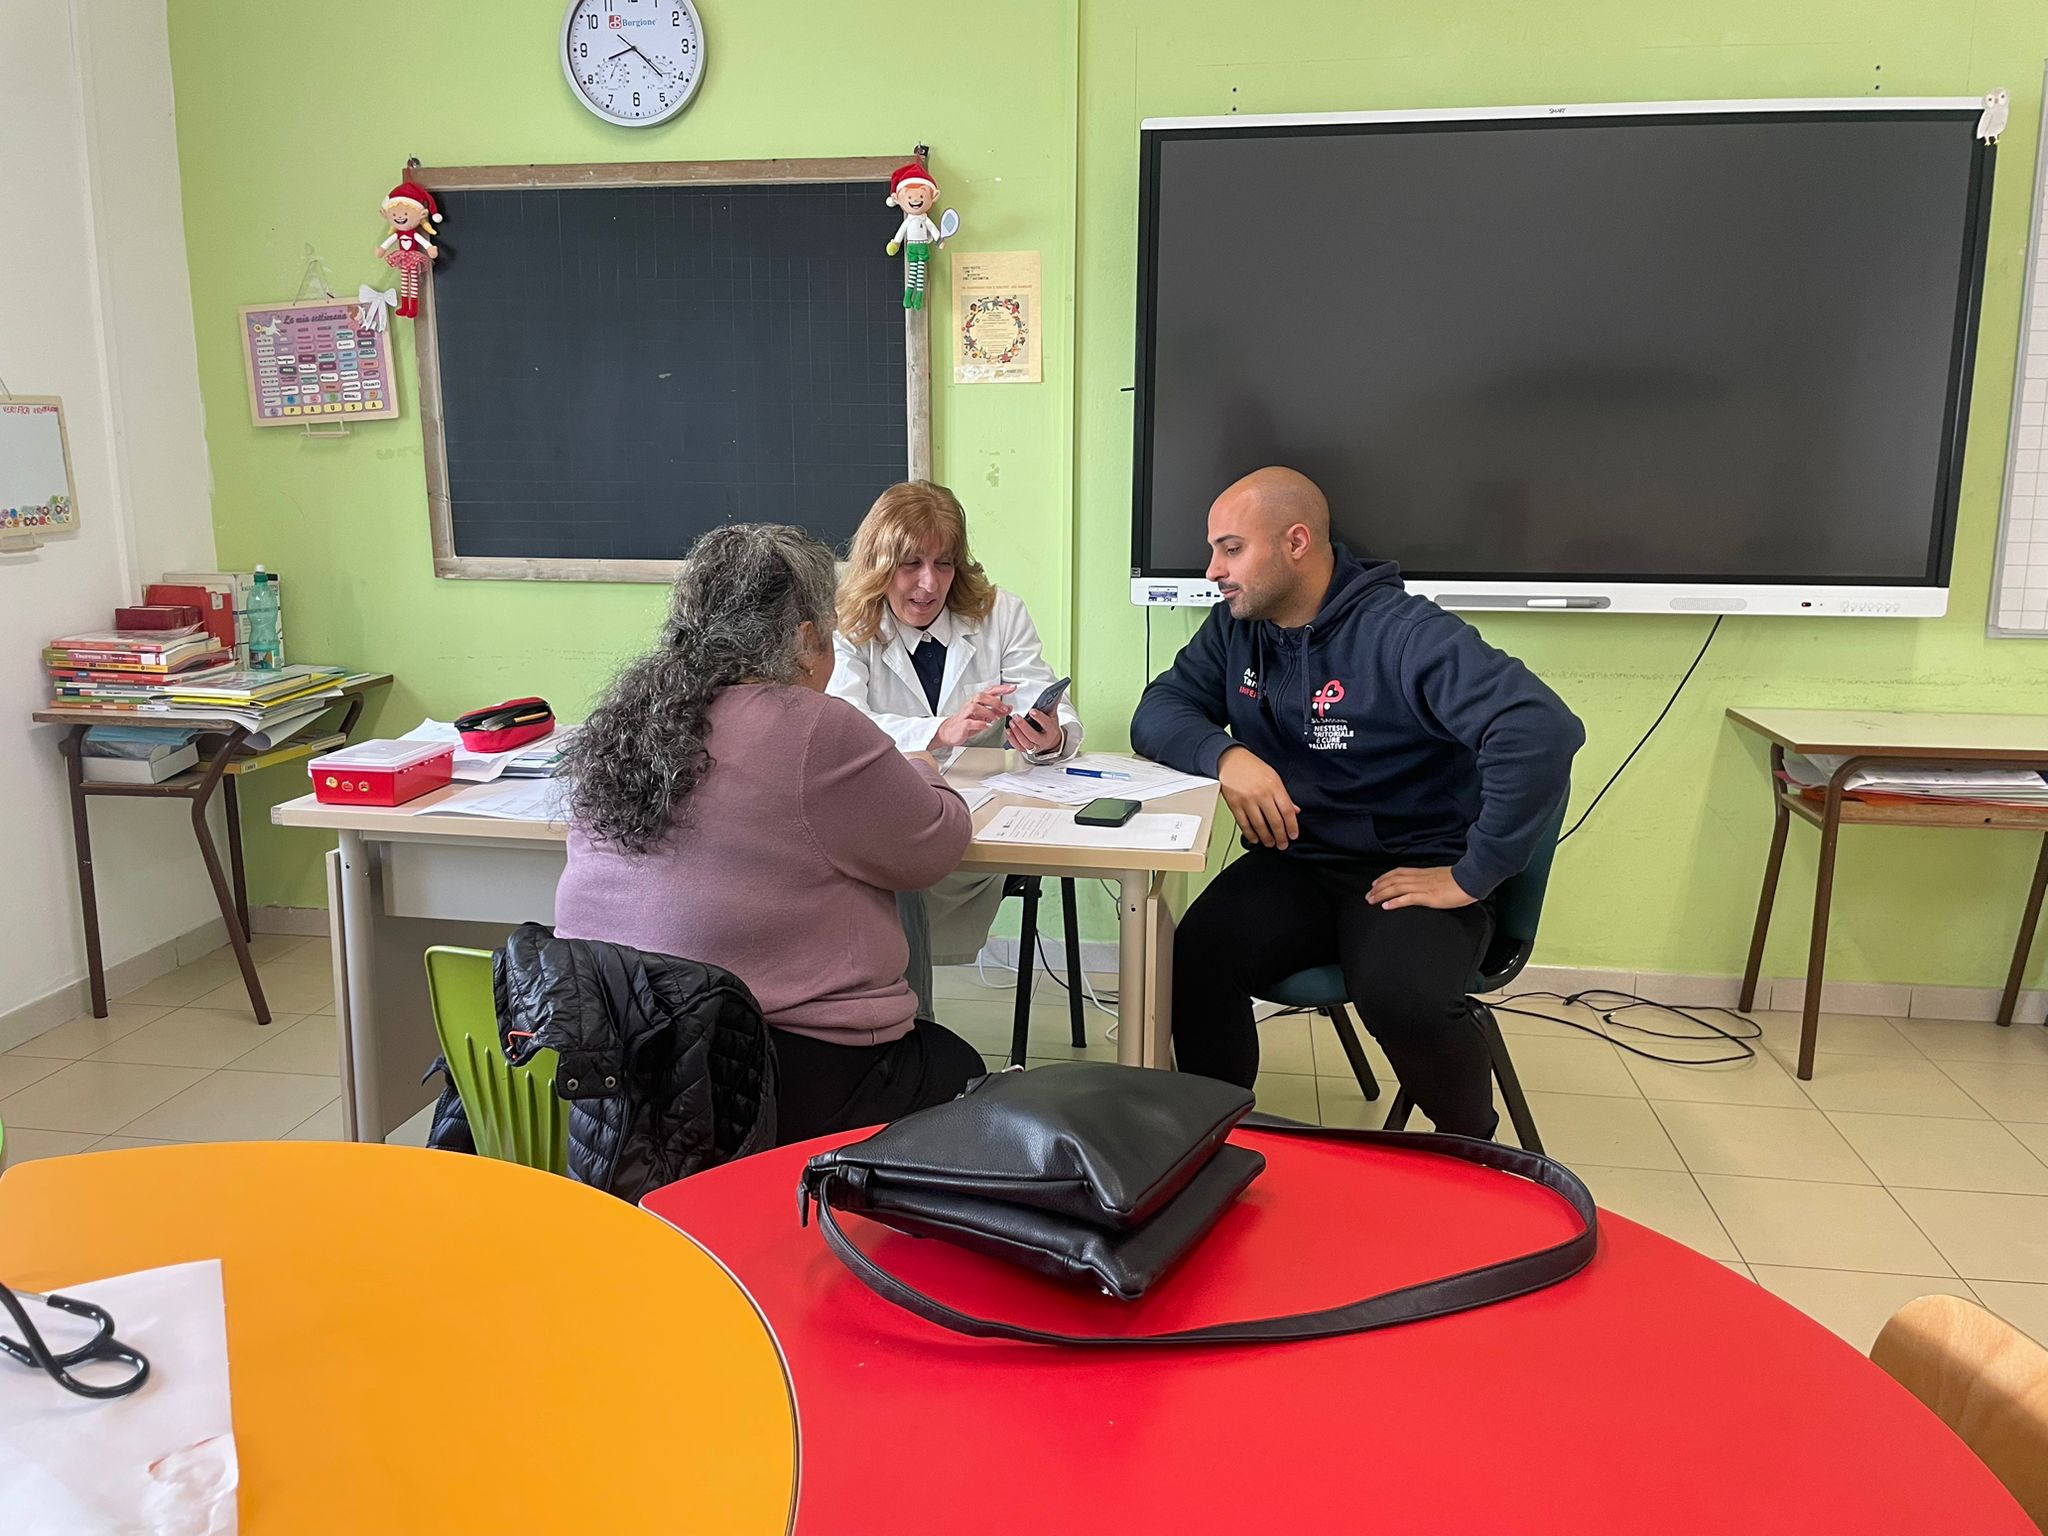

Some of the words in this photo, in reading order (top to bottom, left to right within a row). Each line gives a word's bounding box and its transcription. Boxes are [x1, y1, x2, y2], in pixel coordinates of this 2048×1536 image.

[587, 14, 598, 30] 10
[671, 11, 680, 27] 2
[580, 42, 588, 58] 9
[681, 38, 689, 54] 3
[587, 74, 594, 85] 8
[677, 71, 684, 81] 4
[608, 94, 614, 104] 7
[632, 91, 641, 107] 6
[659, 92, 666, 103] 5
[283, 315, 295, 325] La
[296, 313, 310, 323] mia
[311, 312, 347, 322] settimana
